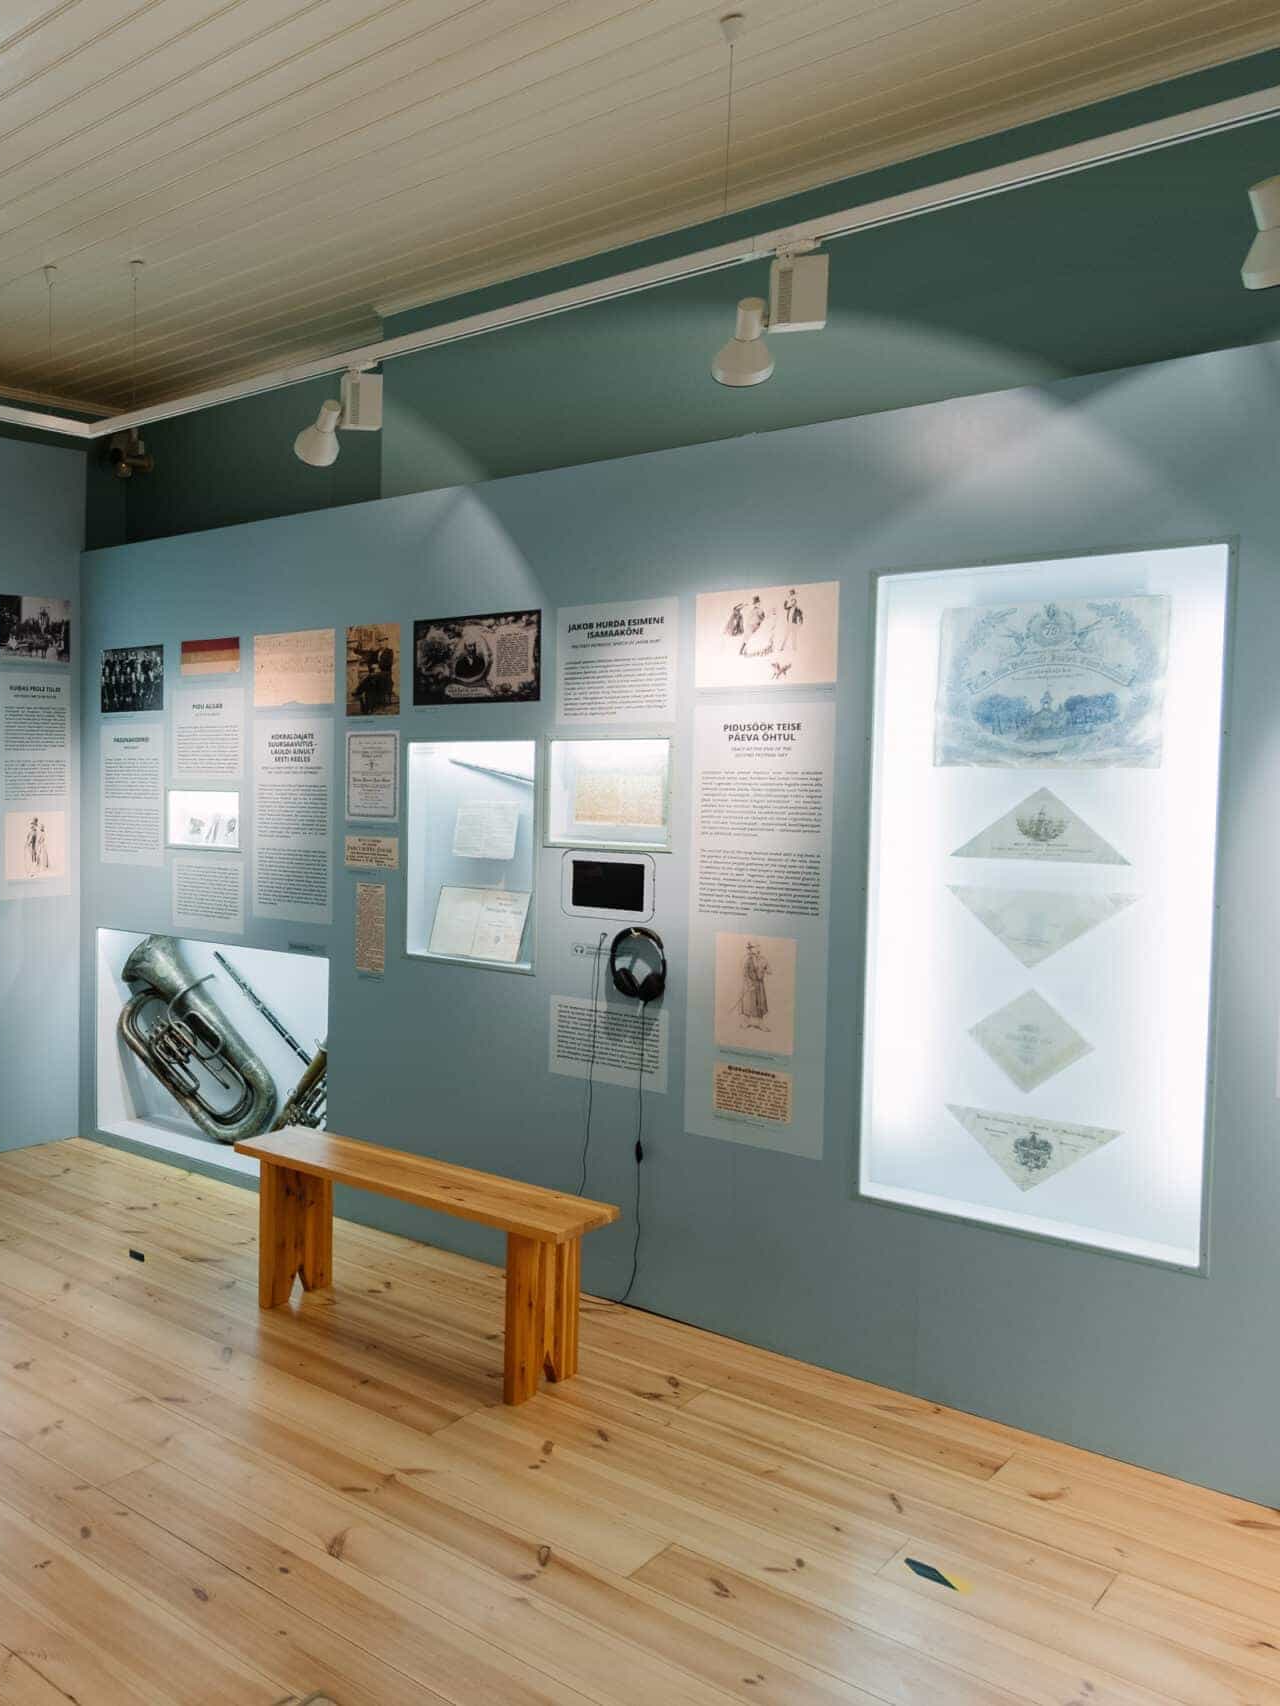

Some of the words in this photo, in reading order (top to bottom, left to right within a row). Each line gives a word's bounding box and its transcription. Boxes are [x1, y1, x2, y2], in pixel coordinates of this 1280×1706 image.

[568, 622, 594, 633] JAKOB
[596, 620, 626, 630] HURDA
[628, 616, 664, 626] ESIMENE
[587, 627, 644, 639] ISAMAAKÕNE
[776, 722, 802, 731] TEISE
[728, 732, 760, 742] PÄEVA
